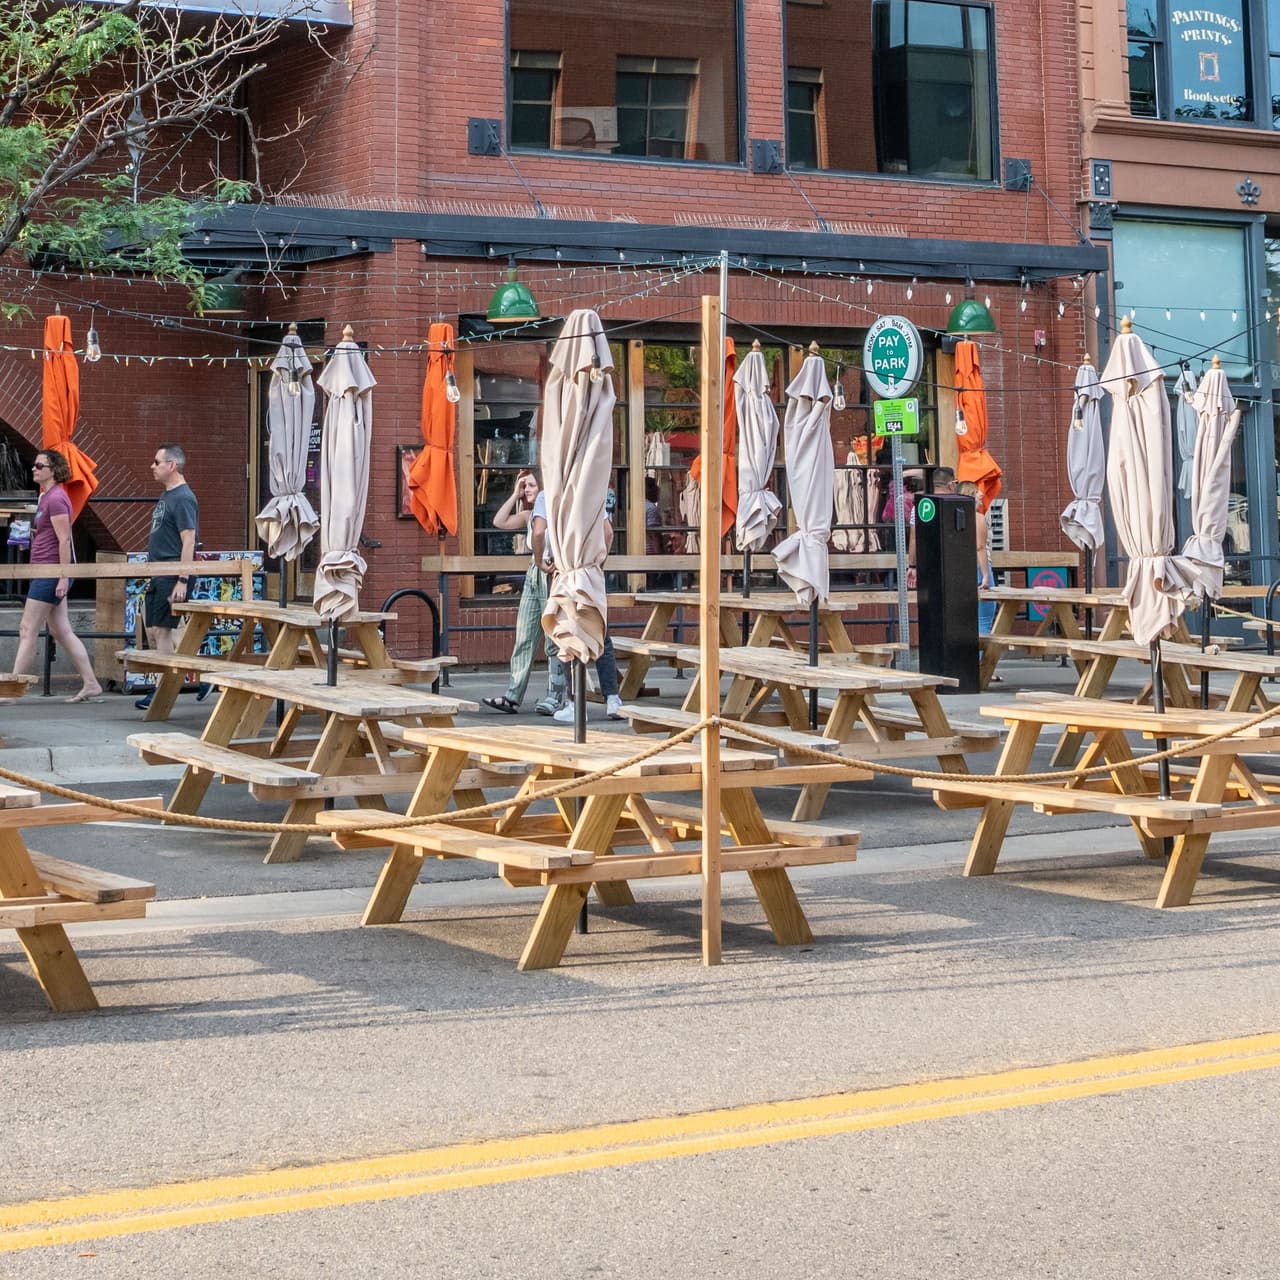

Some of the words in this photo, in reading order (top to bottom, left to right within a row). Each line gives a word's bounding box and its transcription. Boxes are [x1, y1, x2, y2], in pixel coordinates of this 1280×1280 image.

[1183, 88, 1220, 103] Books
[878, 335, 900, 348] PAY
[874, 356, 906, 370] PARK
